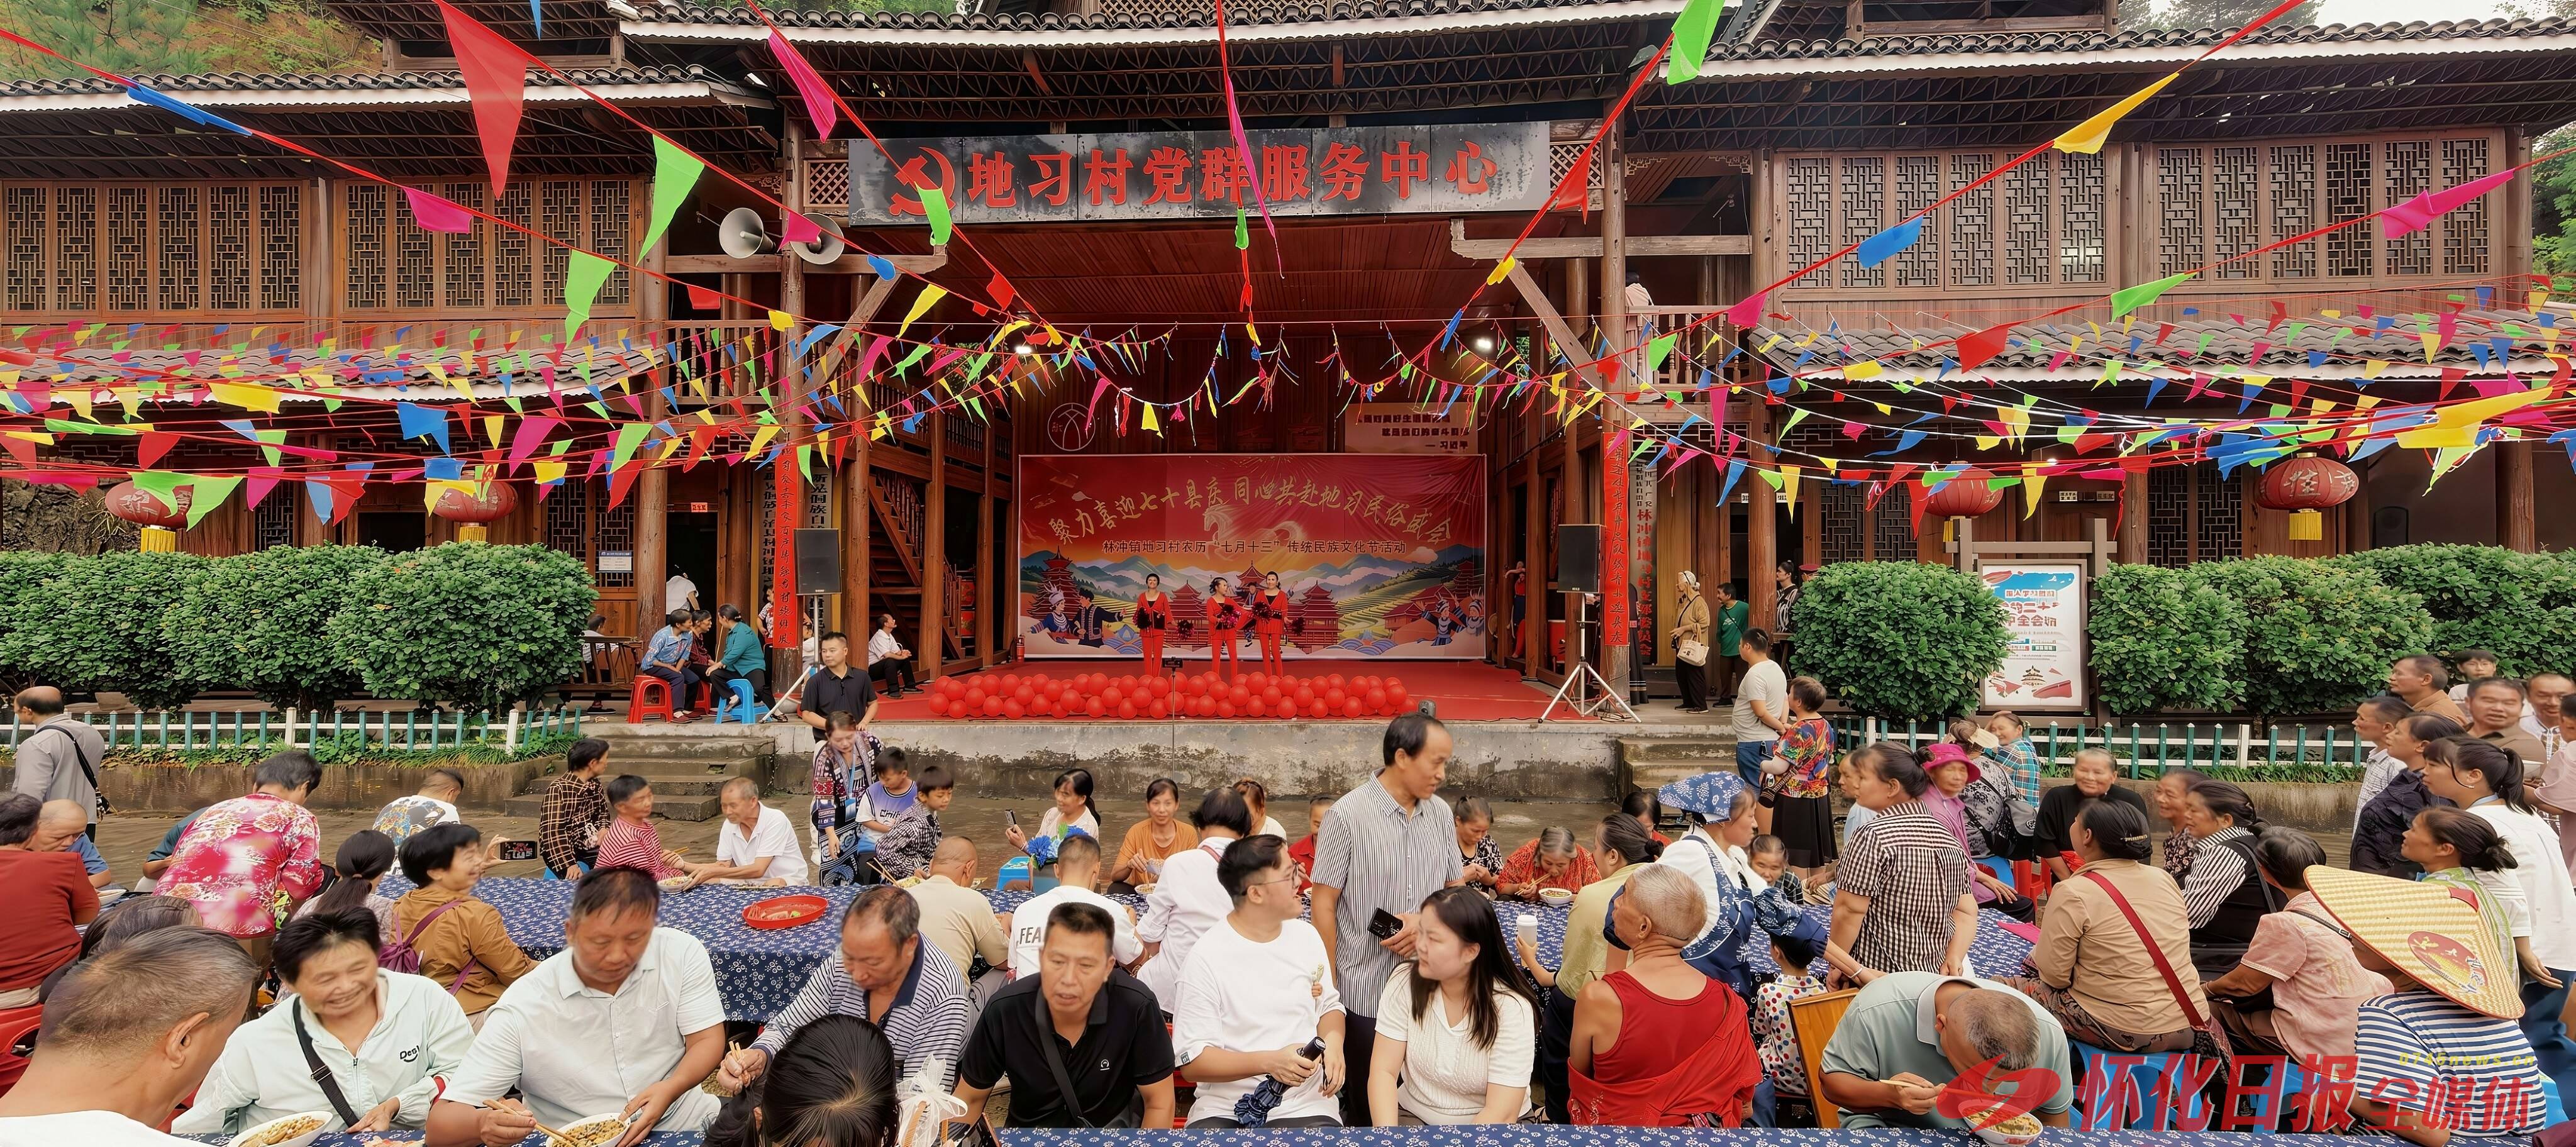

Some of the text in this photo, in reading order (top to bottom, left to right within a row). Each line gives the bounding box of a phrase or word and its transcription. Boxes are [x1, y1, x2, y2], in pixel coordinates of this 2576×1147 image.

[967, 140, 1497, 209] 地习村党群服务中心
